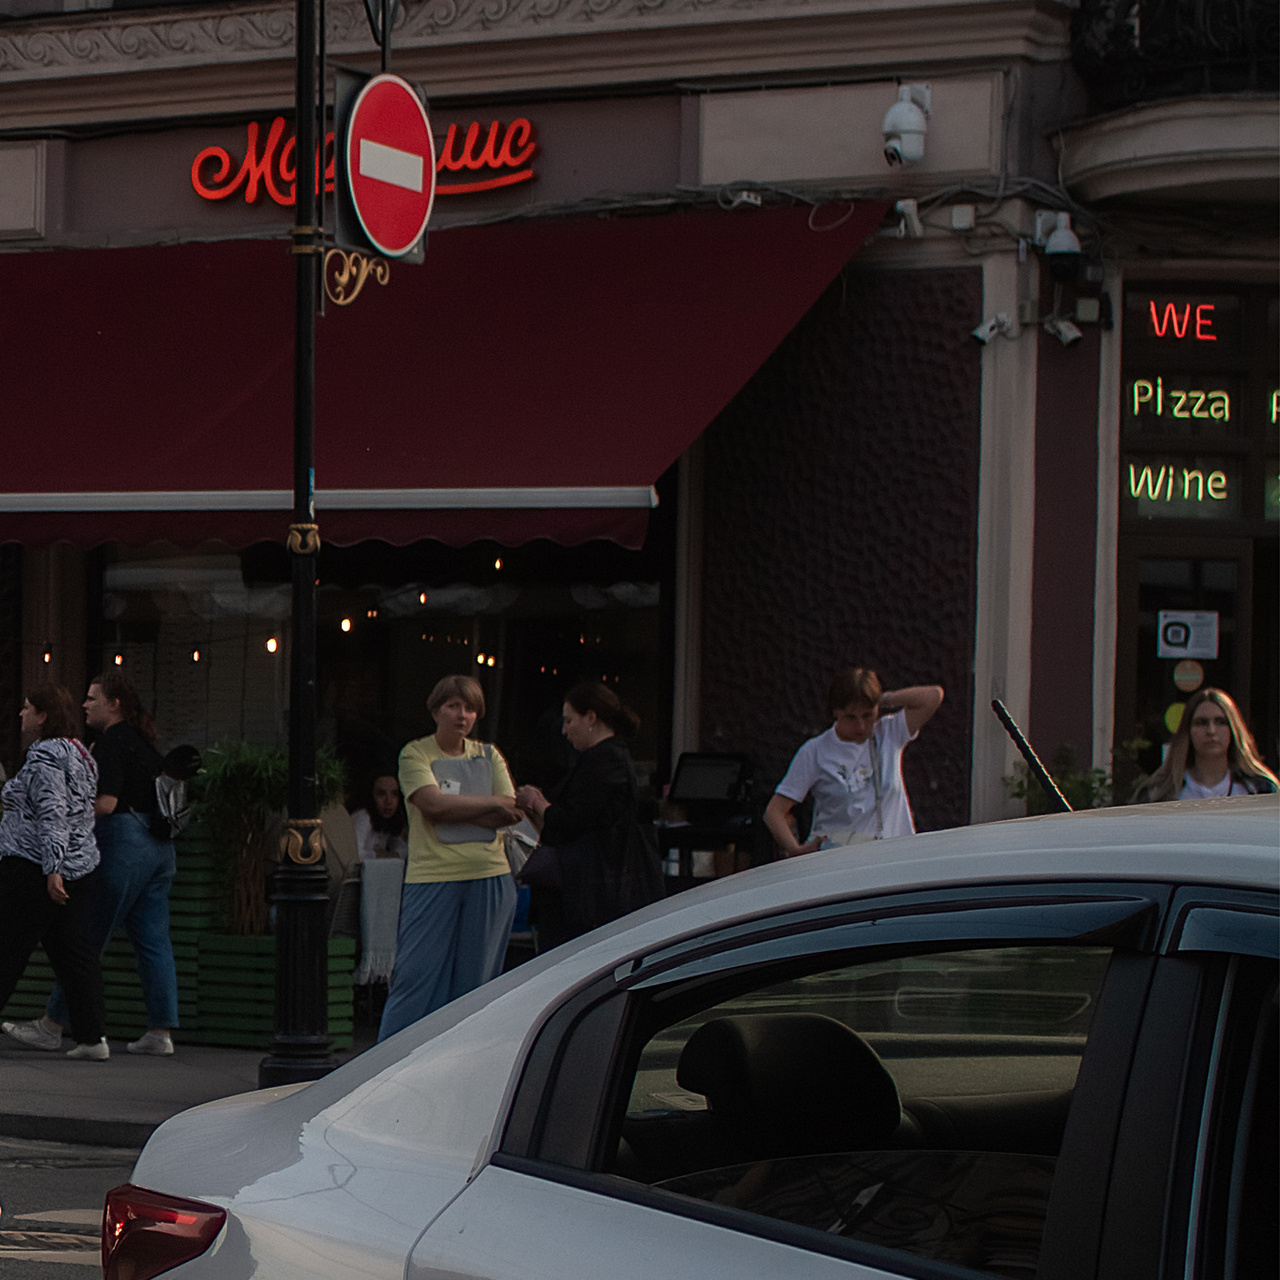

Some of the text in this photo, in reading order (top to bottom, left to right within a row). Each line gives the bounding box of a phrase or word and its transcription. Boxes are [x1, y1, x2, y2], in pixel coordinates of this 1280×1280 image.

[1149, 299, 1218, 342] WE
[1133, 375, 1231, 423] Pizza
[1128, 463, 1229, 502] Wine
